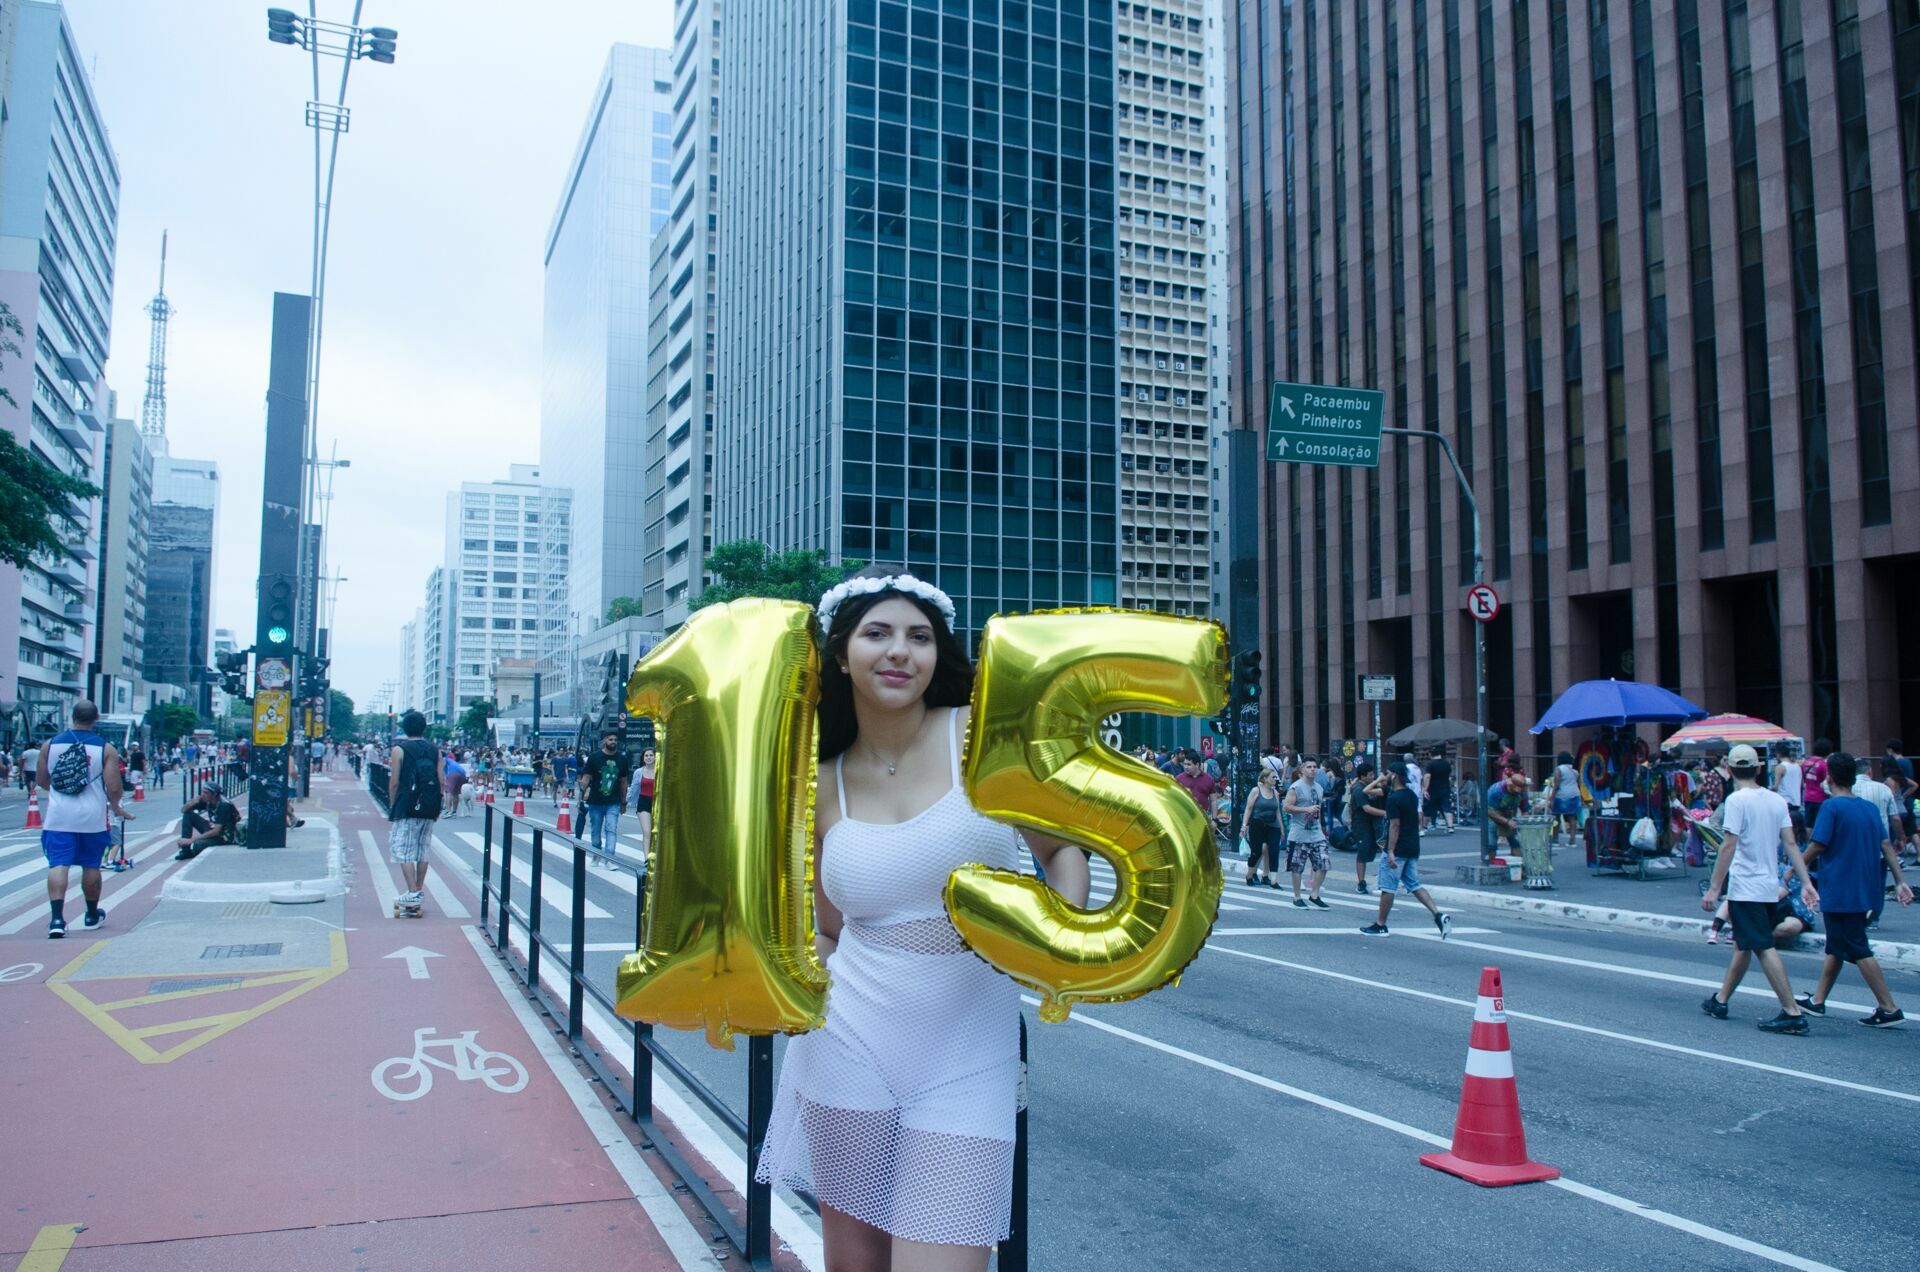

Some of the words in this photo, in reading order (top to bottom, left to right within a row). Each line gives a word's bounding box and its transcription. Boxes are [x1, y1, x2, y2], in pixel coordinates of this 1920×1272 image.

[1304, 393, 1371, 411] Pacaembu
[1301, 413, 1362, 430] Pinheiros
[1296, 440, 1372, 460] Consolação
[1478, 592, 1490, 614] E
